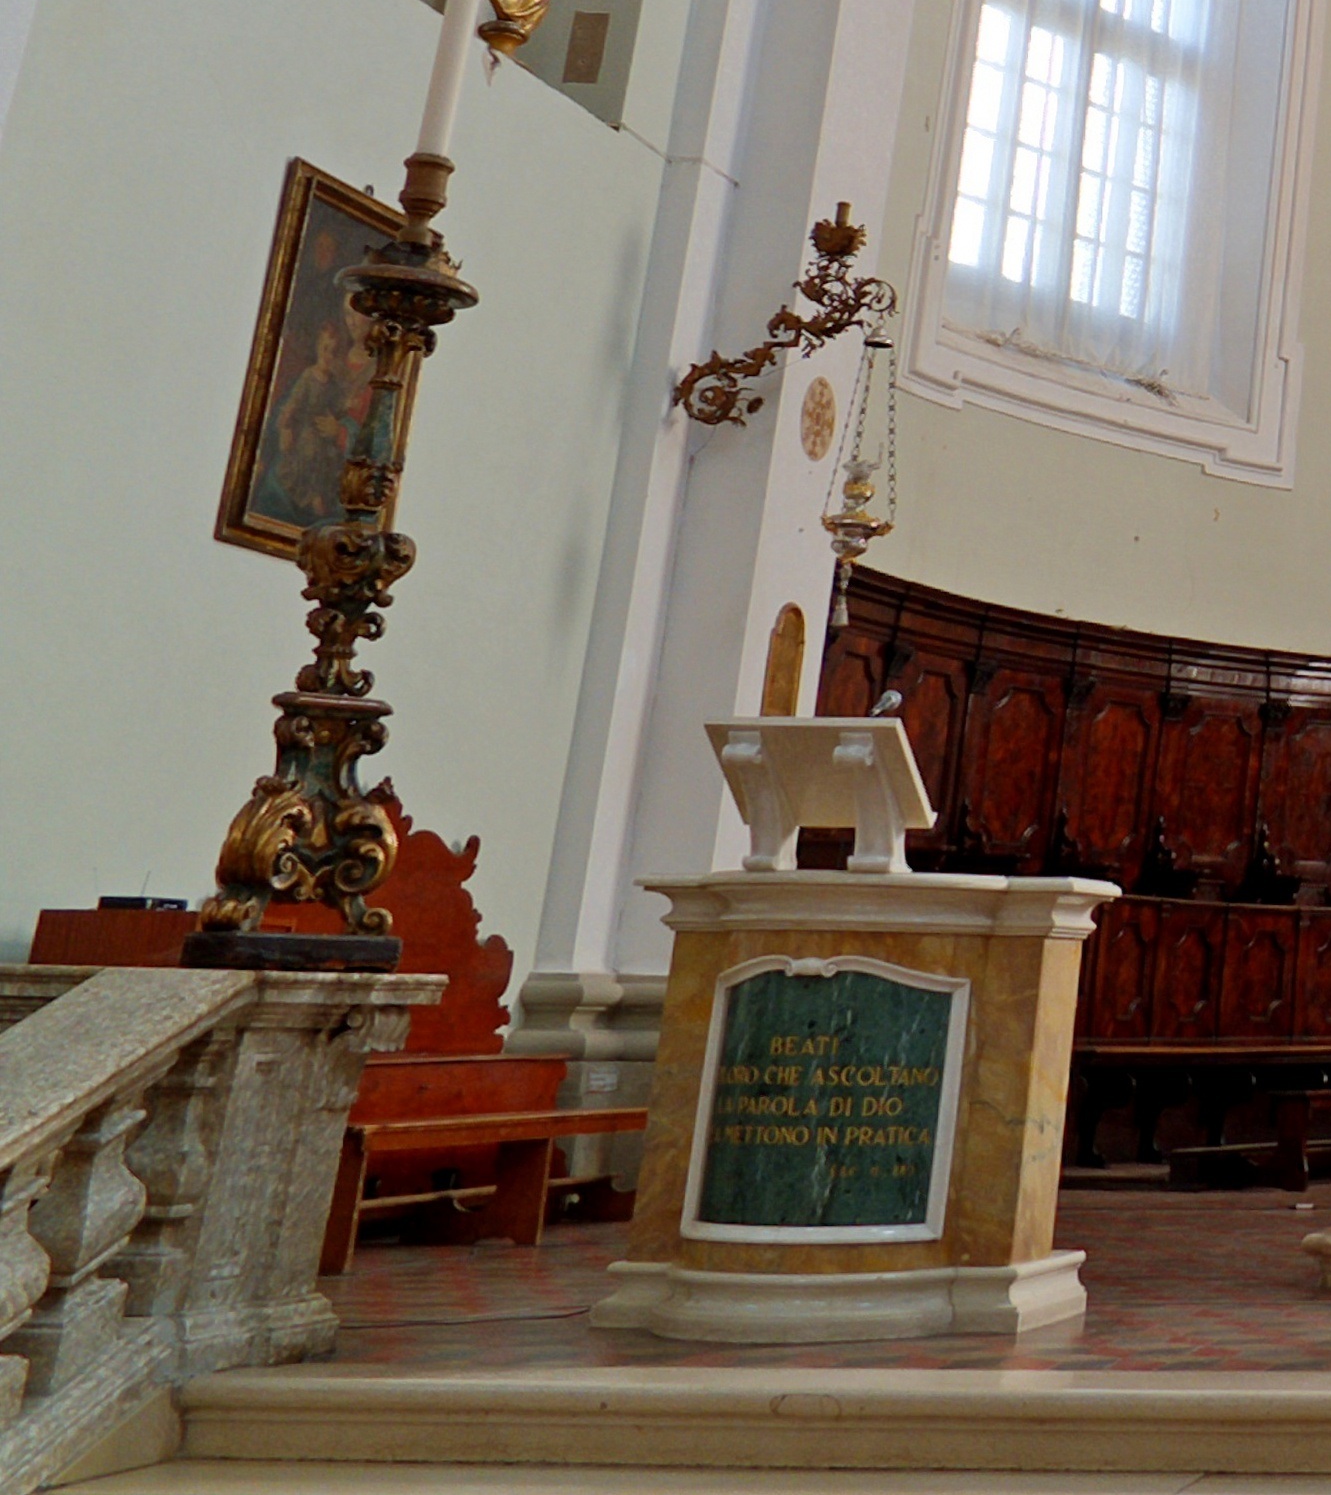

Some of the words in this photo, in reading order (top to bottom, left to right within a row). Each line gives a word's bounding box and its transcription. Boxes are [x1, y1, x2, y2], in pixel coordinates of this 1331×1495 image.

[769, 1035, 840, 1056] BEATI
[763, 1065, 803, 1086] CHE
[811, 1066, 939, 1086] ASCOLTANO
[738, 1096, 819, 1117] PAROLA
[828, 1096, 852, 1117] DI
[861, 1096, 903, 1117] DIO
[816, 1126, 839, 1146] IN
[844, 1125, 931, 1146] PRATICA
